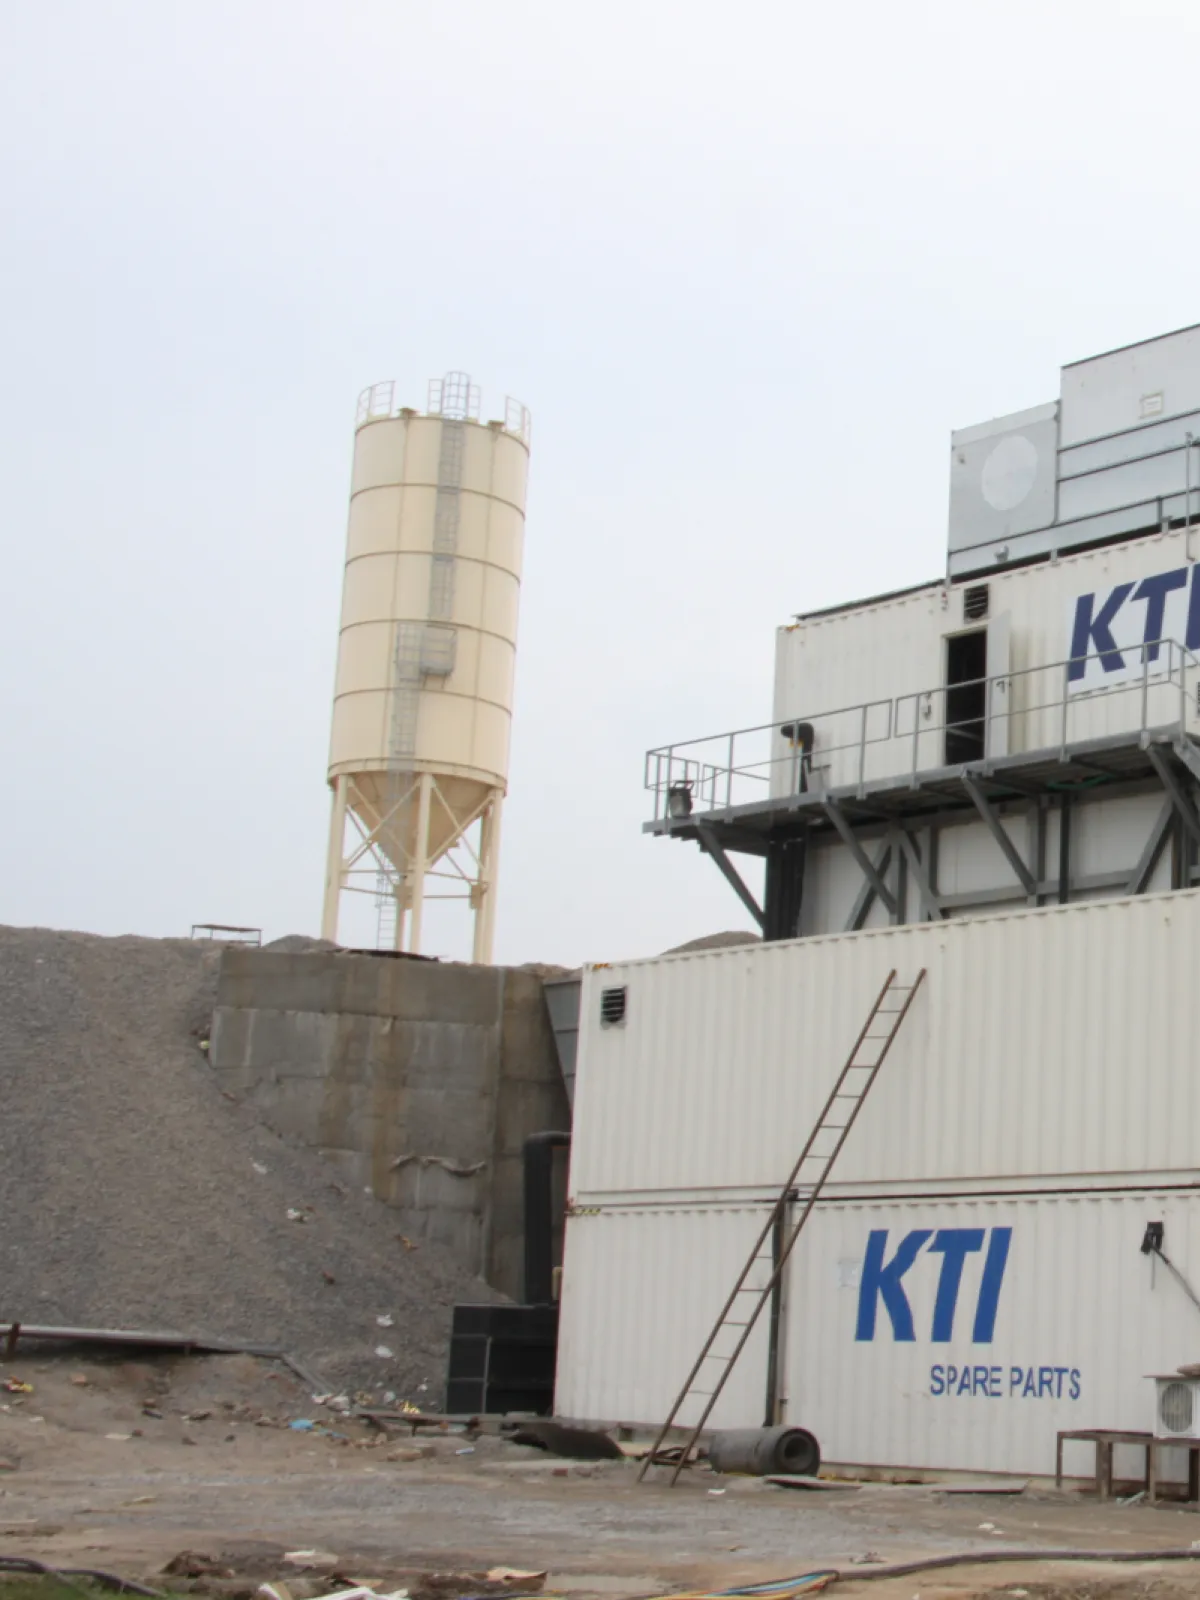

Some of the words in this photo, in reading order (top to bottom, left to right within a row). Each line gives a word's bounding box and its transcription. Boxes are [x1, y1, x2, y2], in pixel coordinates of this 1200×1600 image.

[855, 1227, 1013, 1343] KTI
[930, 1365, 1003, 1397] SPARE
[1010, 1366, 1081, 1400] PARTS
